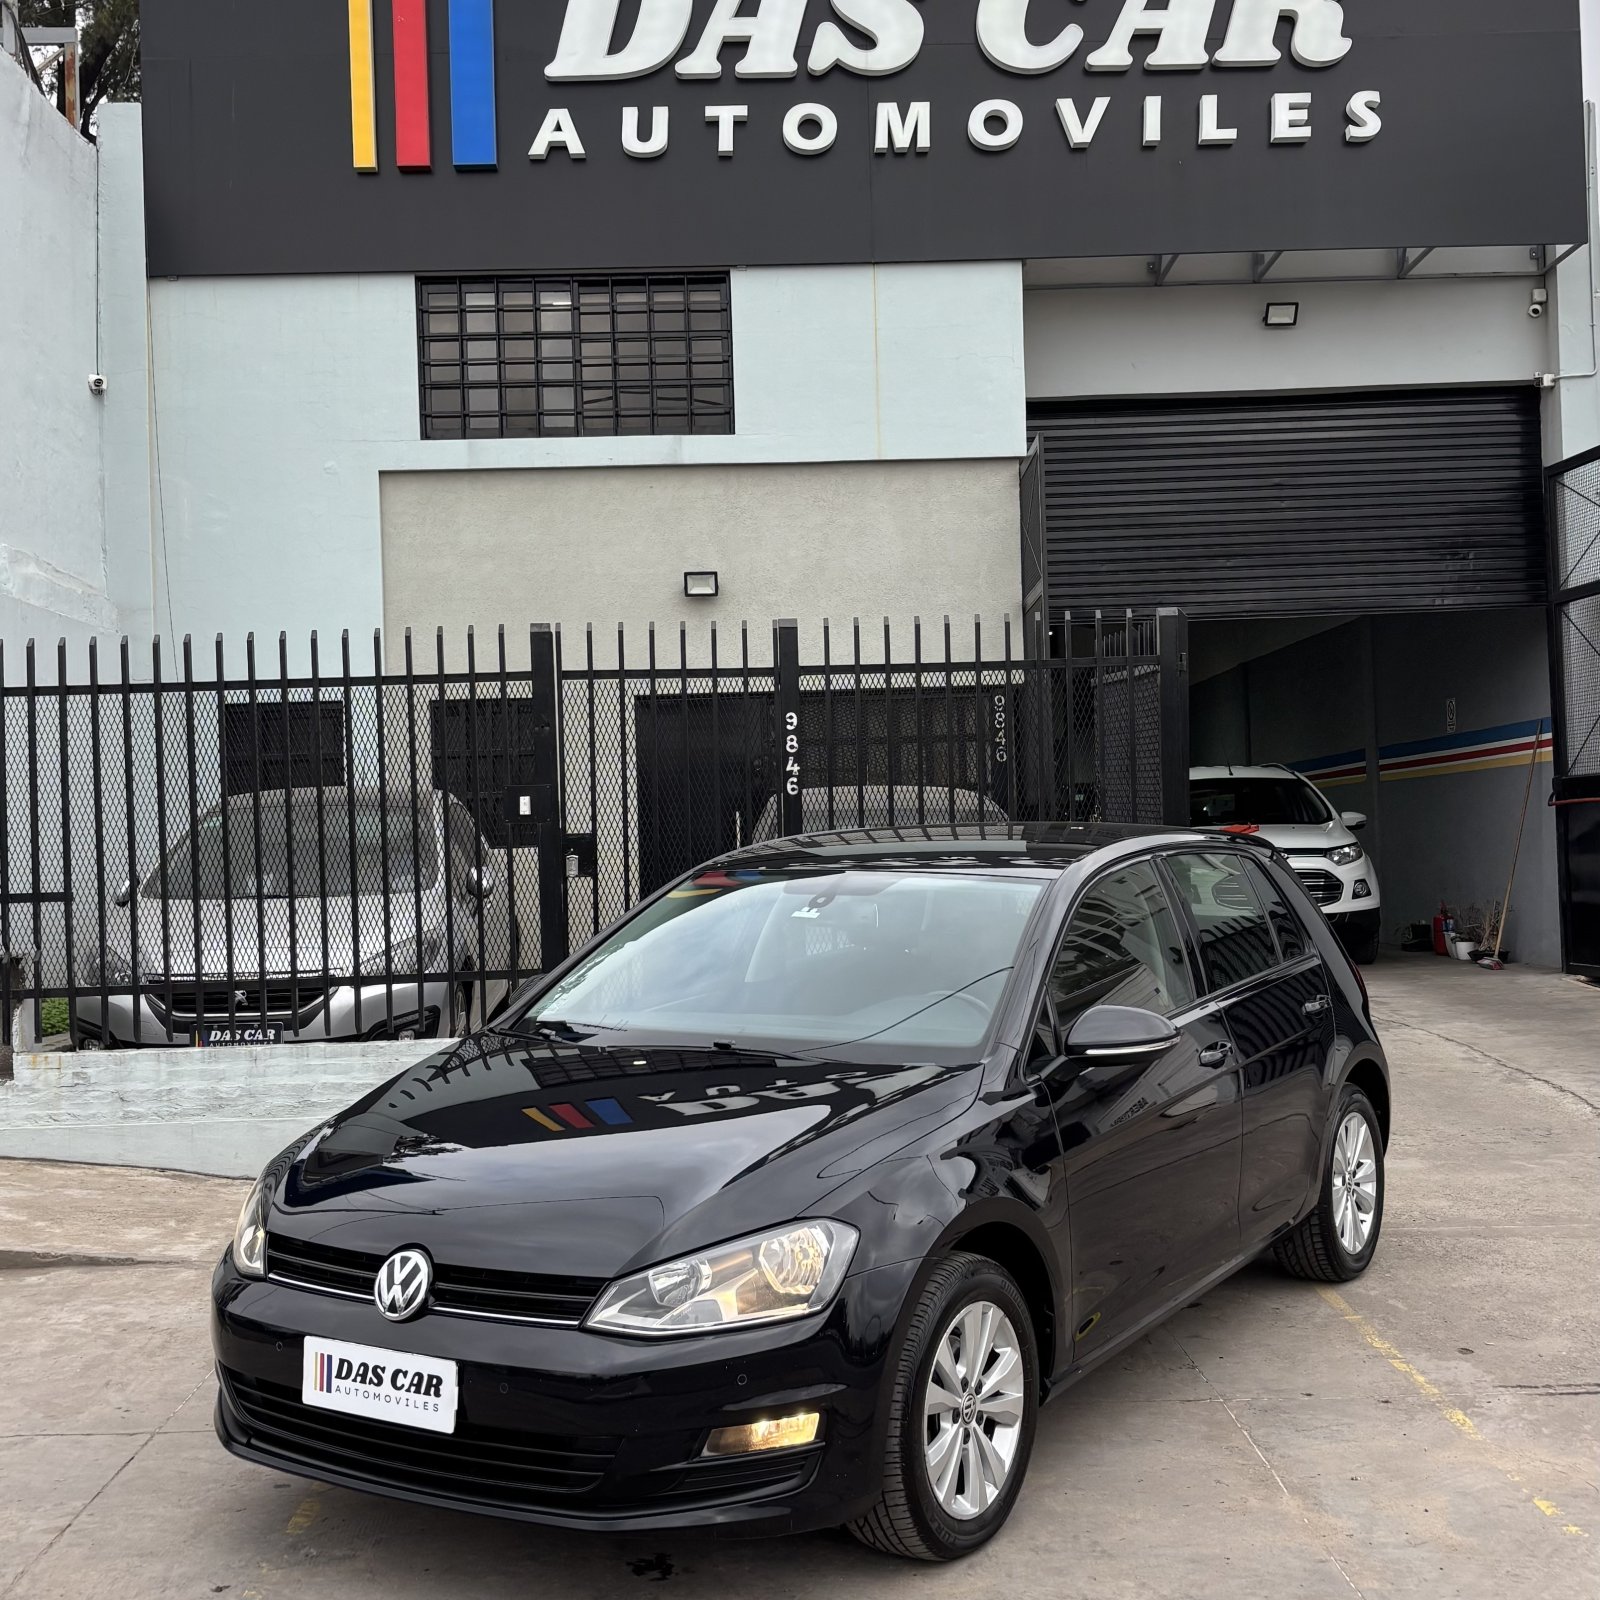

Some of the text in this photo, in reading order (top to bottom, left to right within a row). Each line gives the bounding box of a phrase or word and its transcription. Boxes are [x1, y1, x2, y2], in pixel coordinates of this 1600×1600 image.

[544, 0, 1353, 82] DAS CAR
[527, 90, 1382, 160] AUTOMOVILES
[785, 711, 800, 796] 9846
[334, 1357, 444, 1398] DAS CAR
[334, 1384, 440, 1412] AUTOMOVILES
